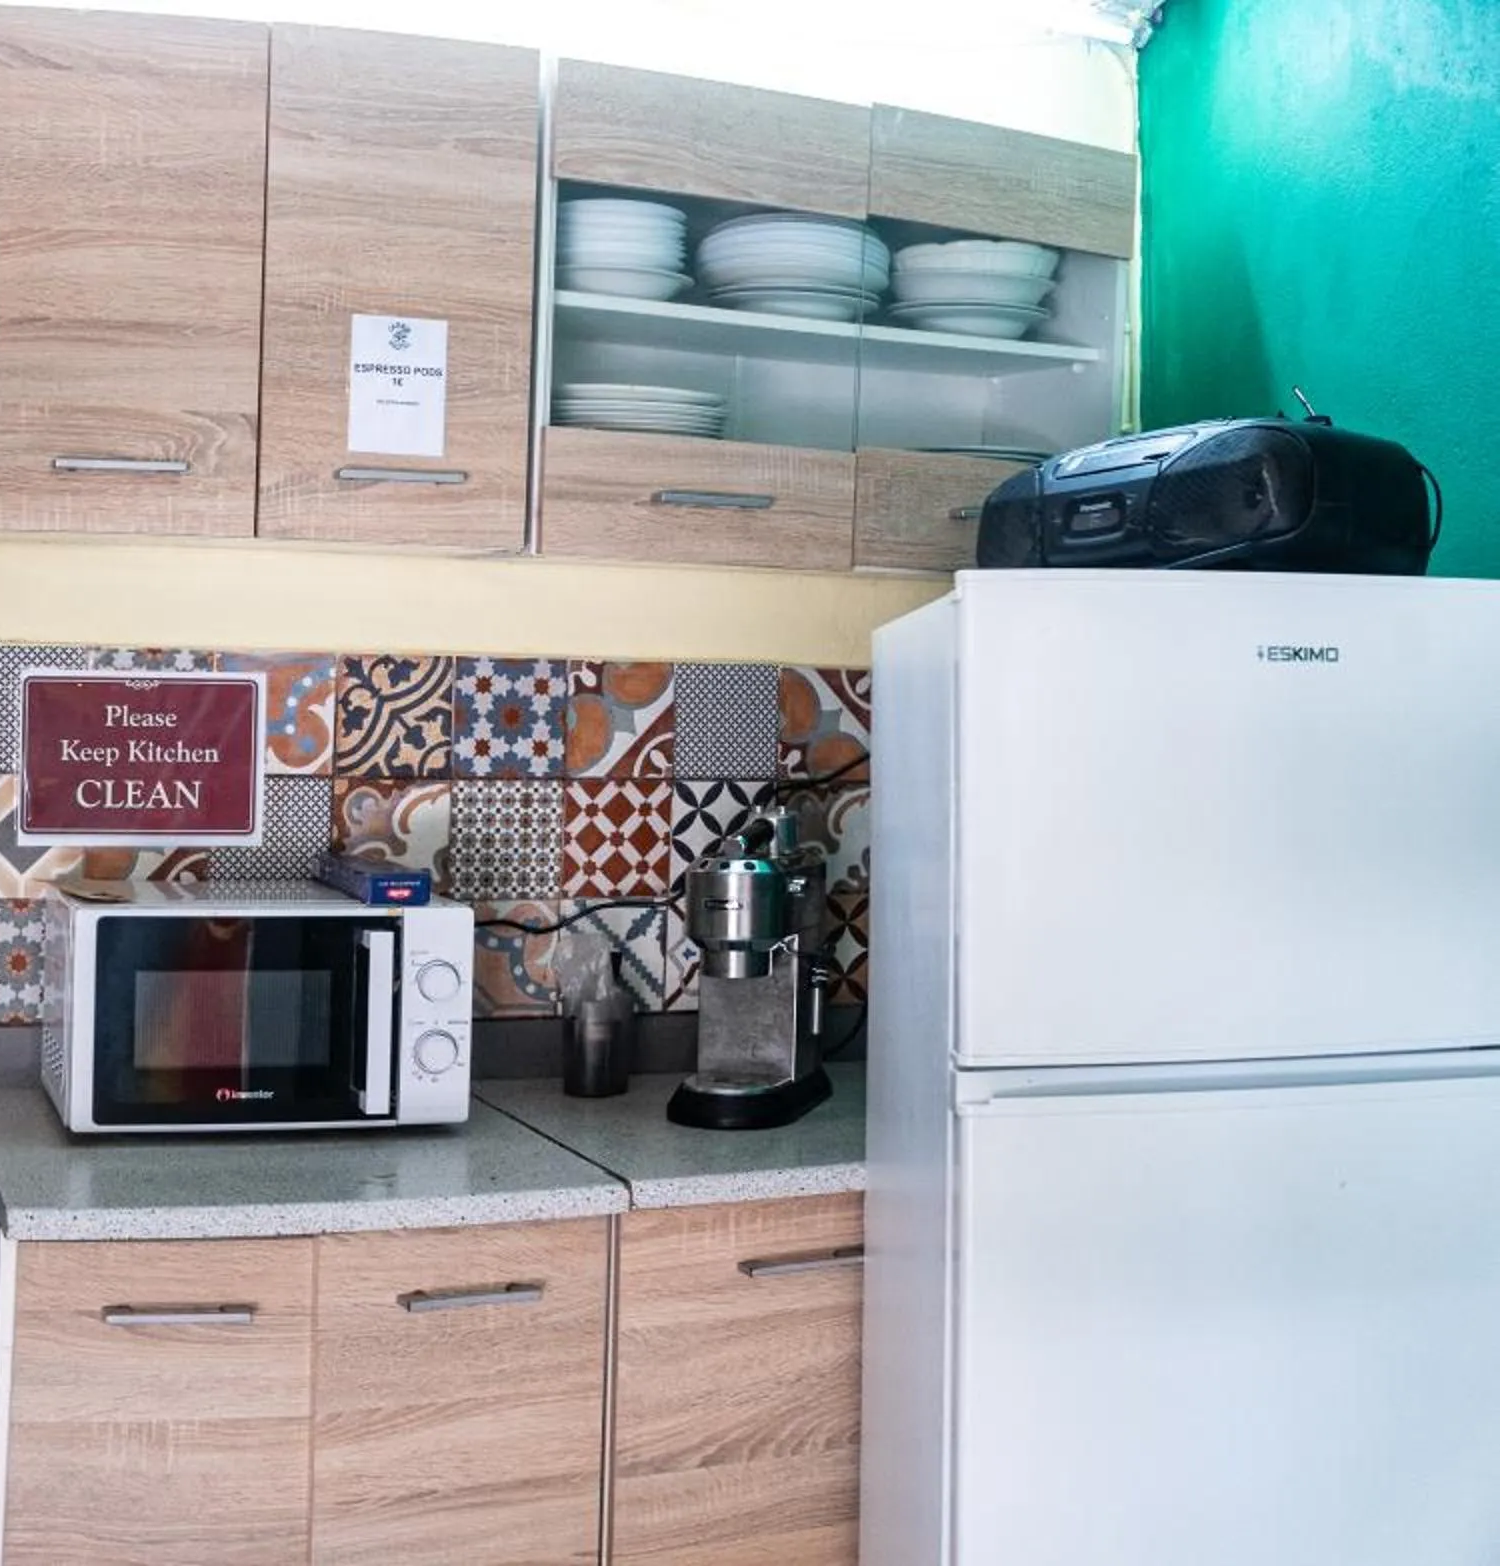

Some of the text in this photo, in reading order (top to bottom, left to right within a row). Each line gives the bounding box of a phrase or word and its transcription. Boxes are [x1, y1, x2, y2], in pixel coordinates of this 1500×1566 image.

[354, 363, 411, 376] ESPRESSO
[1266, 646, 1339, 662] ESKIMO
[104, 704, 178, 729] Please
[60, 739, 220, 767] Keep Kitchen
[75, 779, 203, 810] CLEAN
